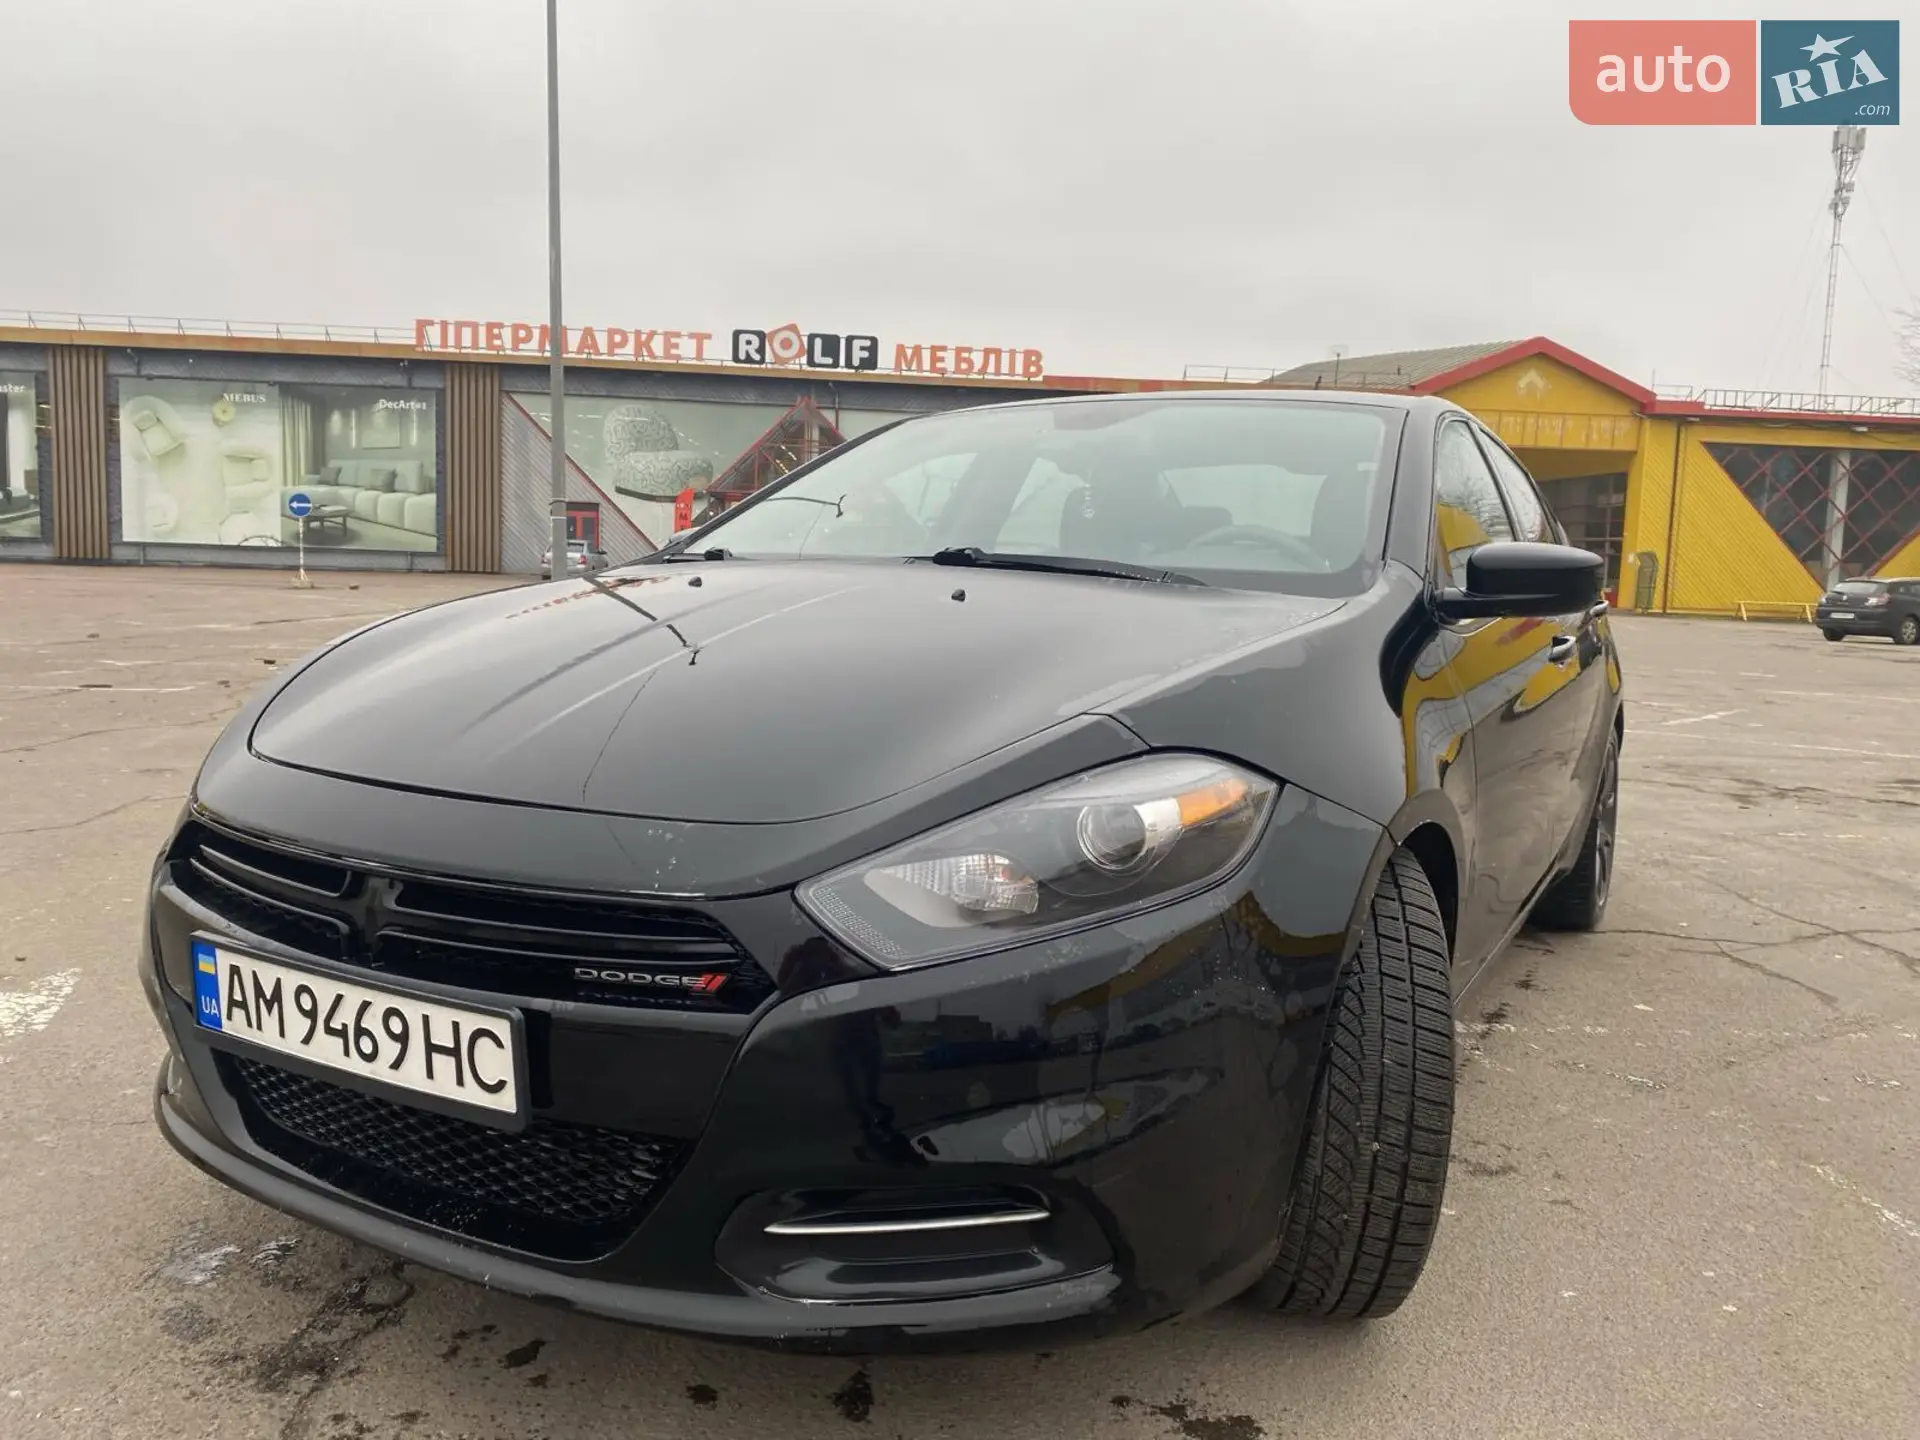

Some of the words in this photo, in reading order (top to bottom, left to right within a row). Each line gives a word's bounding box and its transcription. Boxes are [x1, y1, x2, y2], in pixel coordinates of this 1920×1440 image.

[415, 319, 713, 362] ГІПЕРМАРКЕТ
[738, 329, 872, 367] ROLF
[894, 343, 1044, 378] МЕБЛІВ
[574, 967, 706, 988] DODGE
[201, 995, 220, 1018] UA
